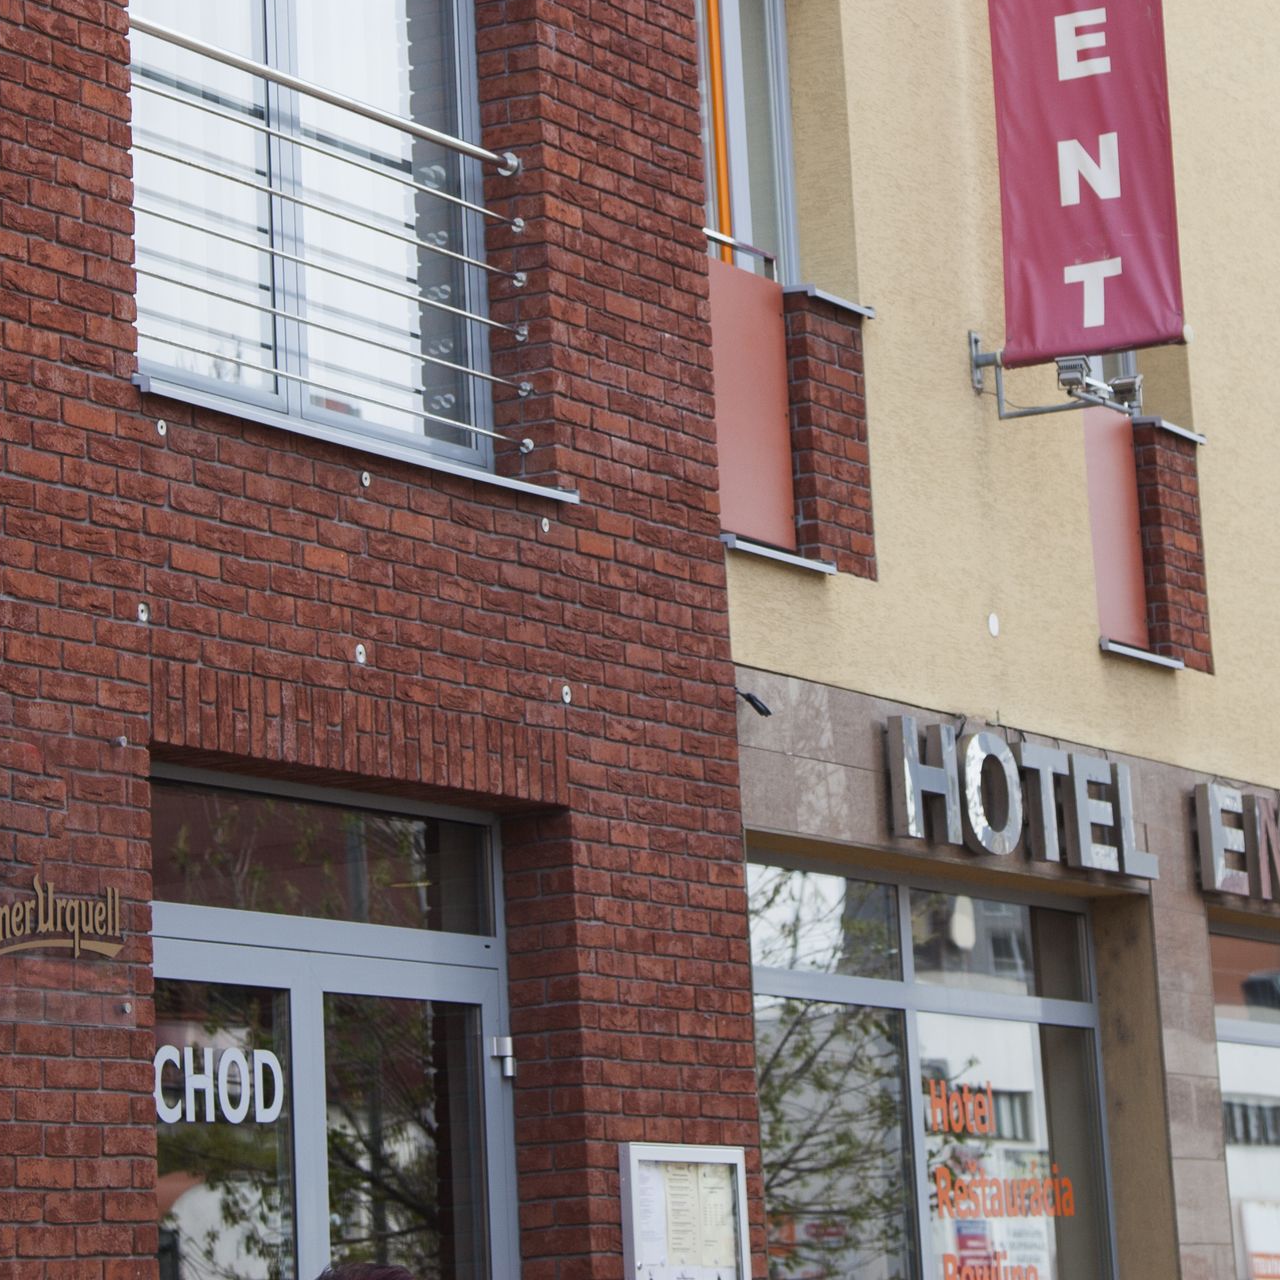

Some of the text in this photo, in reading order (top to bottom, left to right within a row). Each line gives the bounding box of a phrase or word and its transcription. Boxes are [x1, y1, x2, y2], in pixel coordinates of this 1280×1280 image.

[887, 715, 1159, 880] HOTEL
[33, 873, 120, 959] Urquell
[153, 1044, 284, 1124] CHOD
[929, 1079, 996, 1134] Hotel
[935, 1159, 1075, 1218] Reštaurácia
